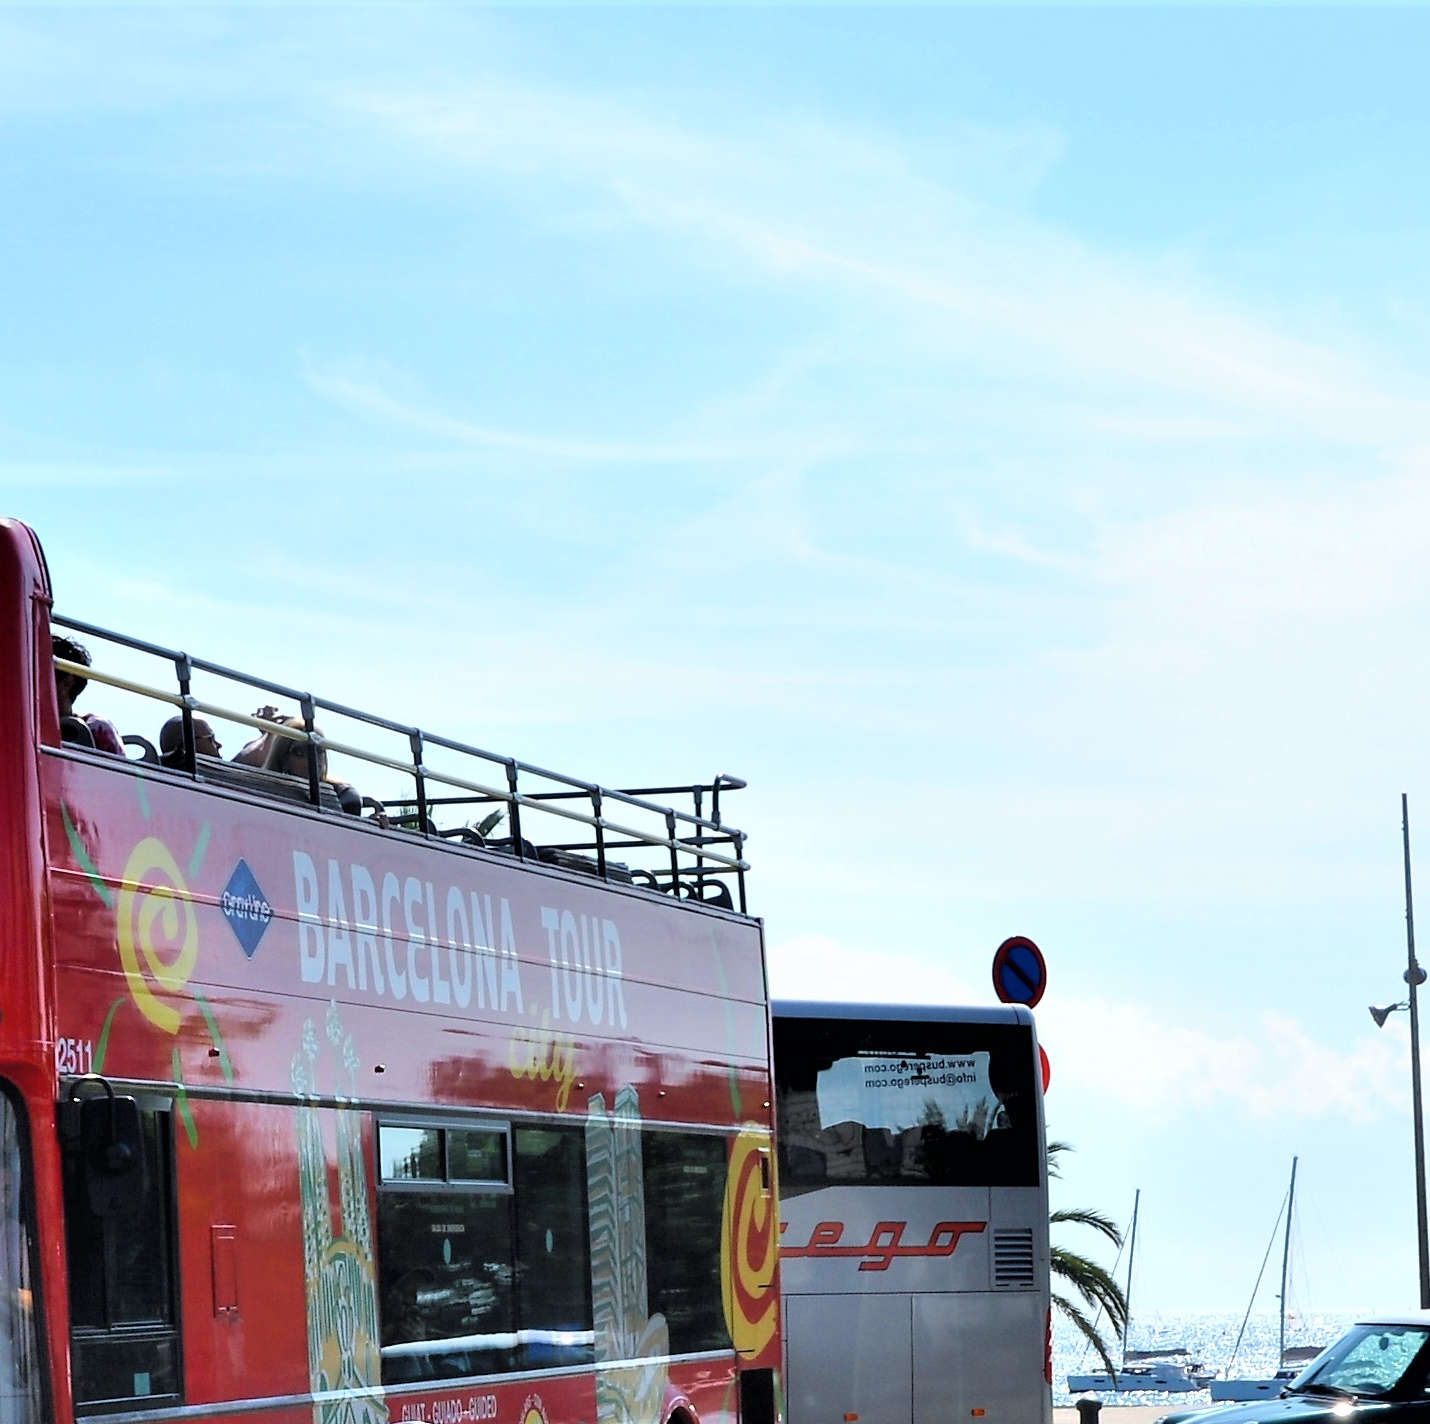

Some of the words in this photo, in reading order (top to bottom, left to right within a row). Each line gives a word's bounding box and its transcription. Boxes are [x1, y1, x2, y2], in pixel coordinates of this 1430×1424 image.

[293, 850, 524, 1014] BARCELONA
[540, 906, 628, 1030] TOUR
[58, 1037, 92, 1073] 2511
[509, 1002, 580, 1112] city
